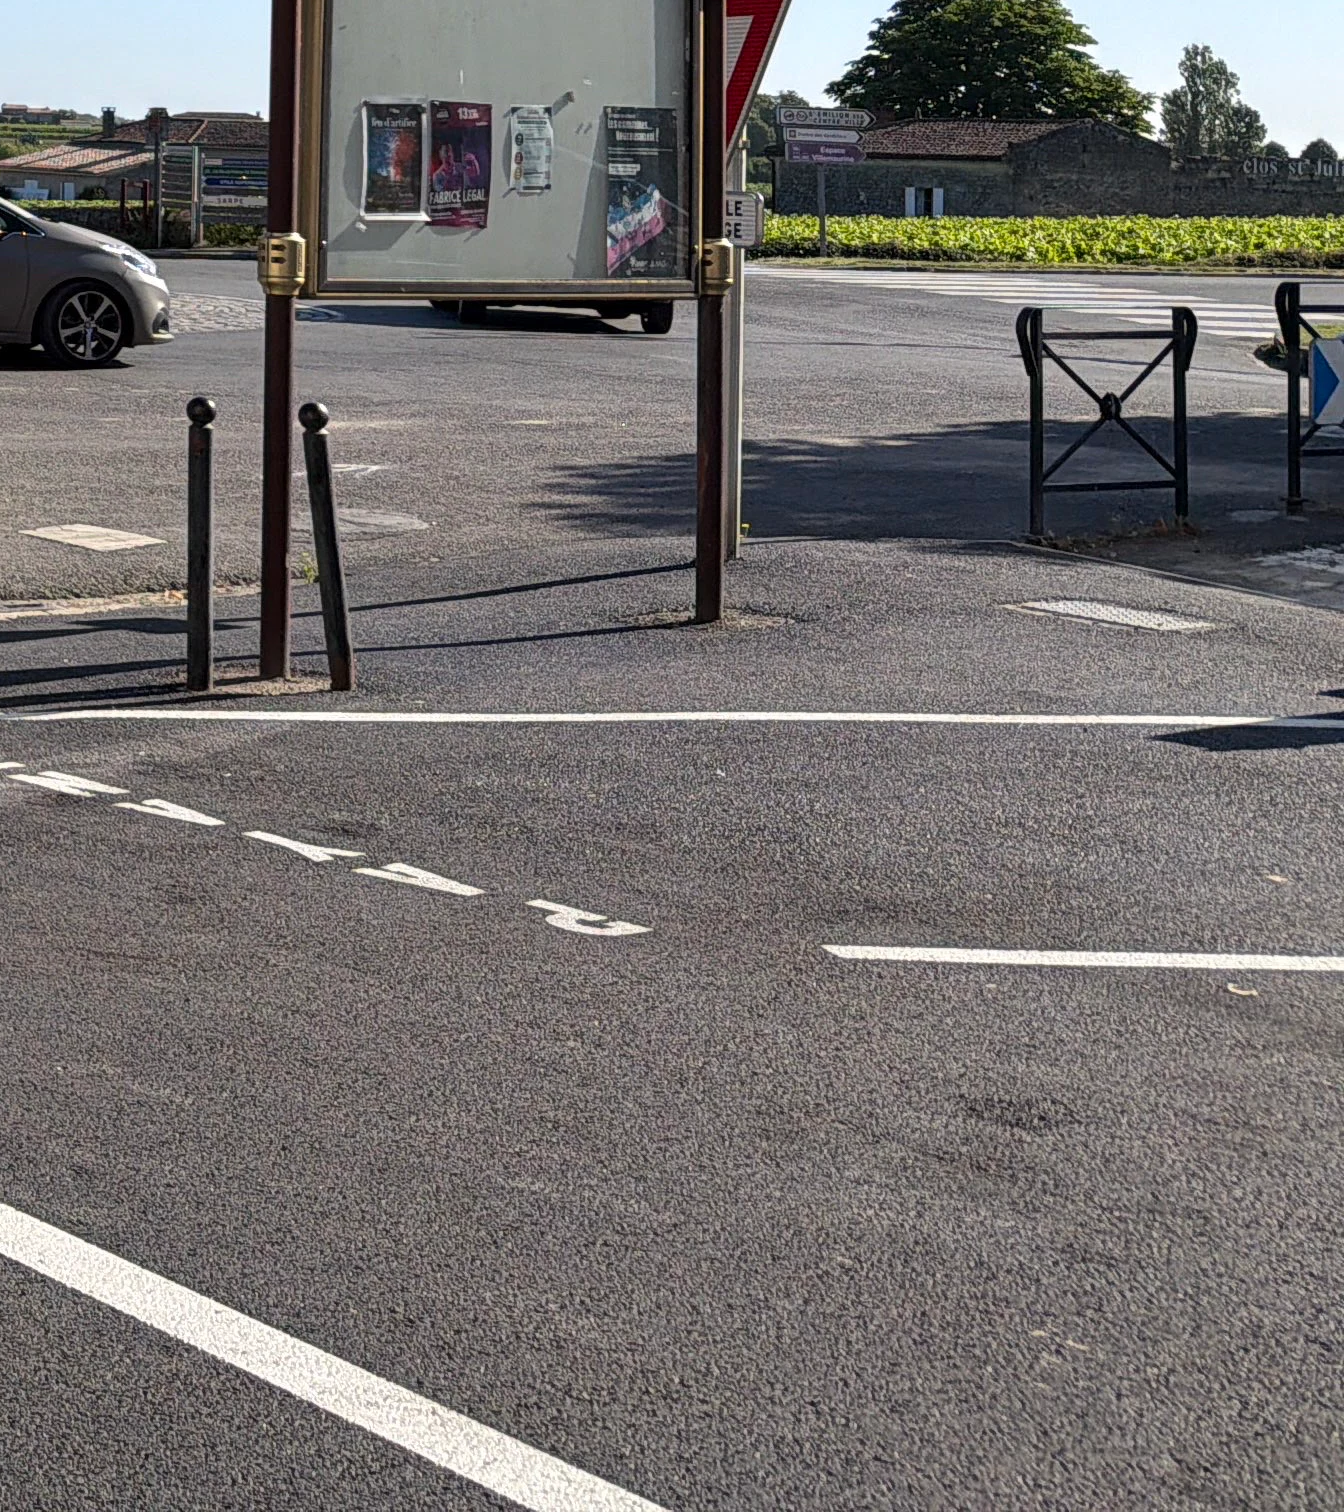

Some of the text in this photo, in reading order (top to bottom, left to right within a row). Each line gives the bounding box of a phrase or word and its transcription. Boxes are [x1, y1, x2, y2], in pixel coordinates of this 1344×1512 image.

[1242, 157, 1278, 175] clos
[216, 197, 245, 205] SARPE
[429, 190, 462, 205] FABRICE
[462, 187, 487, 203] LEGAL
[725, 199, 744, 217] LE
